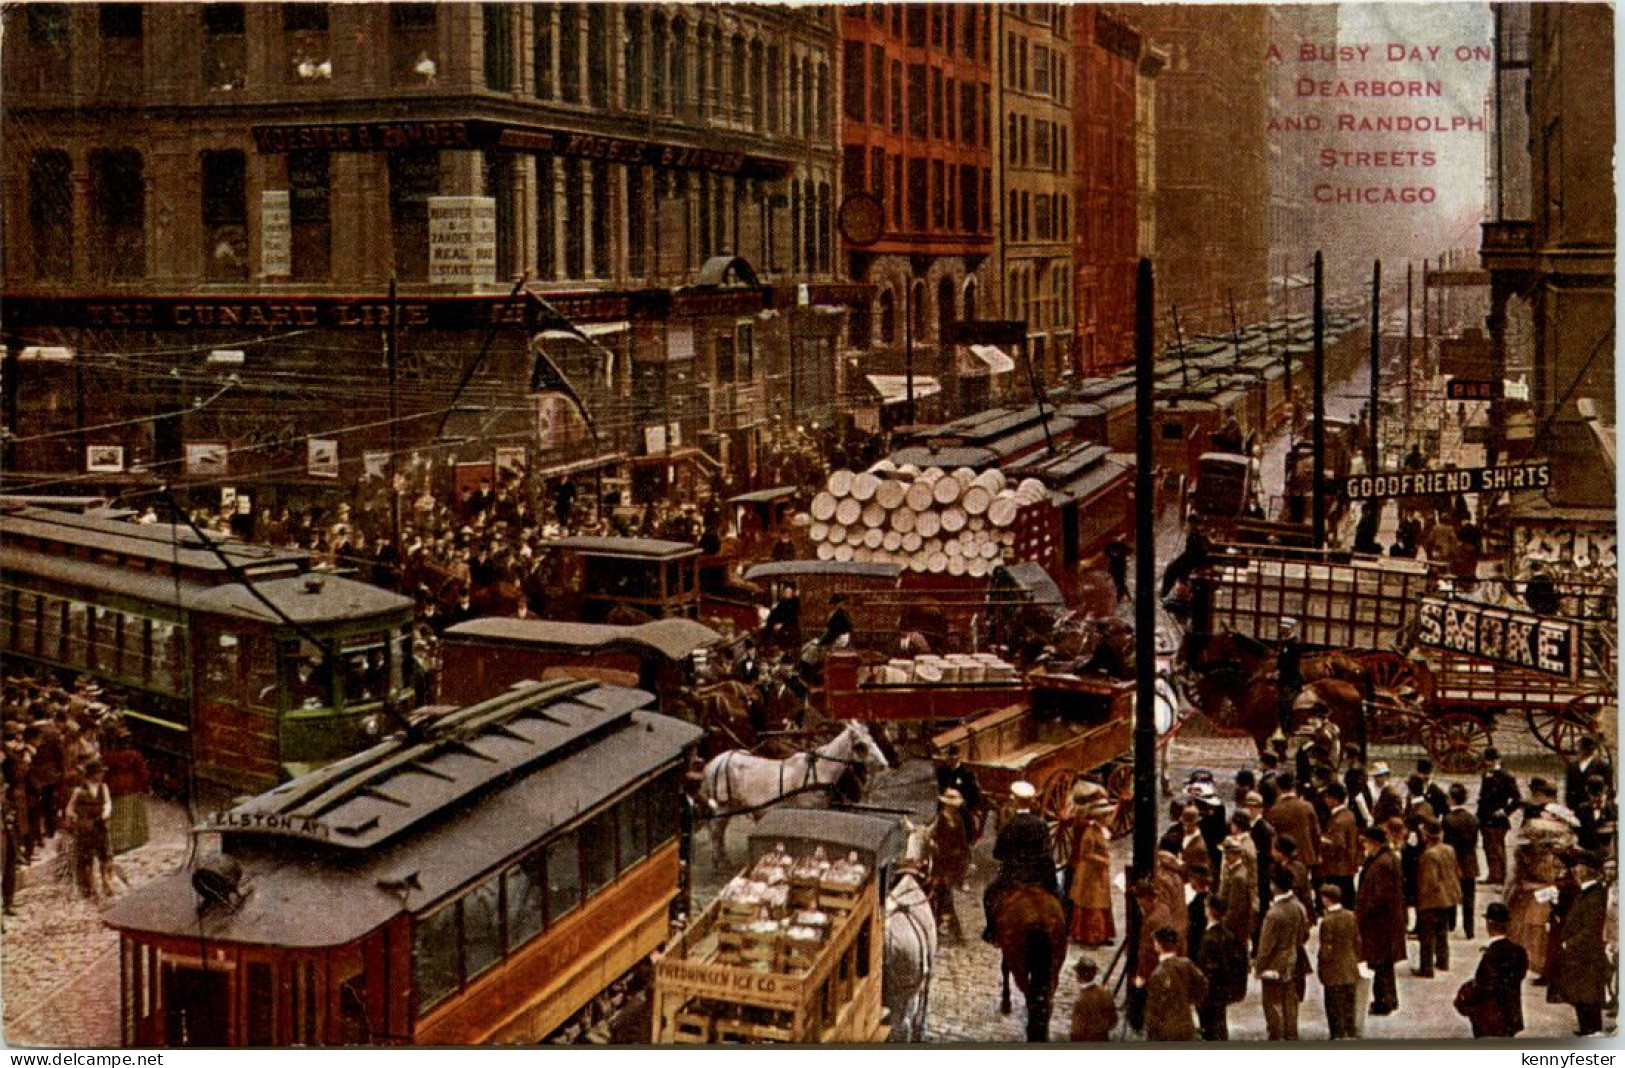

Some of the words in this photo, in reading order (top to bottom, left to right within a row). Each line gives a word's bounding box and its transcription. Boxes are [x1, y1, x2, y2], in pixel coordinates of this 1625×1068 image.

[566, 136, 651, 164] KOESE
[87, 304, 154, 325] THE
[173, 304, 319, 325] CUNARD
[337, 304, 430, 325] LINE
[1347, 471, 1472, 498] GOODFRIEND
[1481, 465, 1550, 490] SHIRTS
[1418, 602, 1565, 674] SMOKE
[216, 813, 292, 828] ELSTON
[733, 975, 753, 989] ICE
